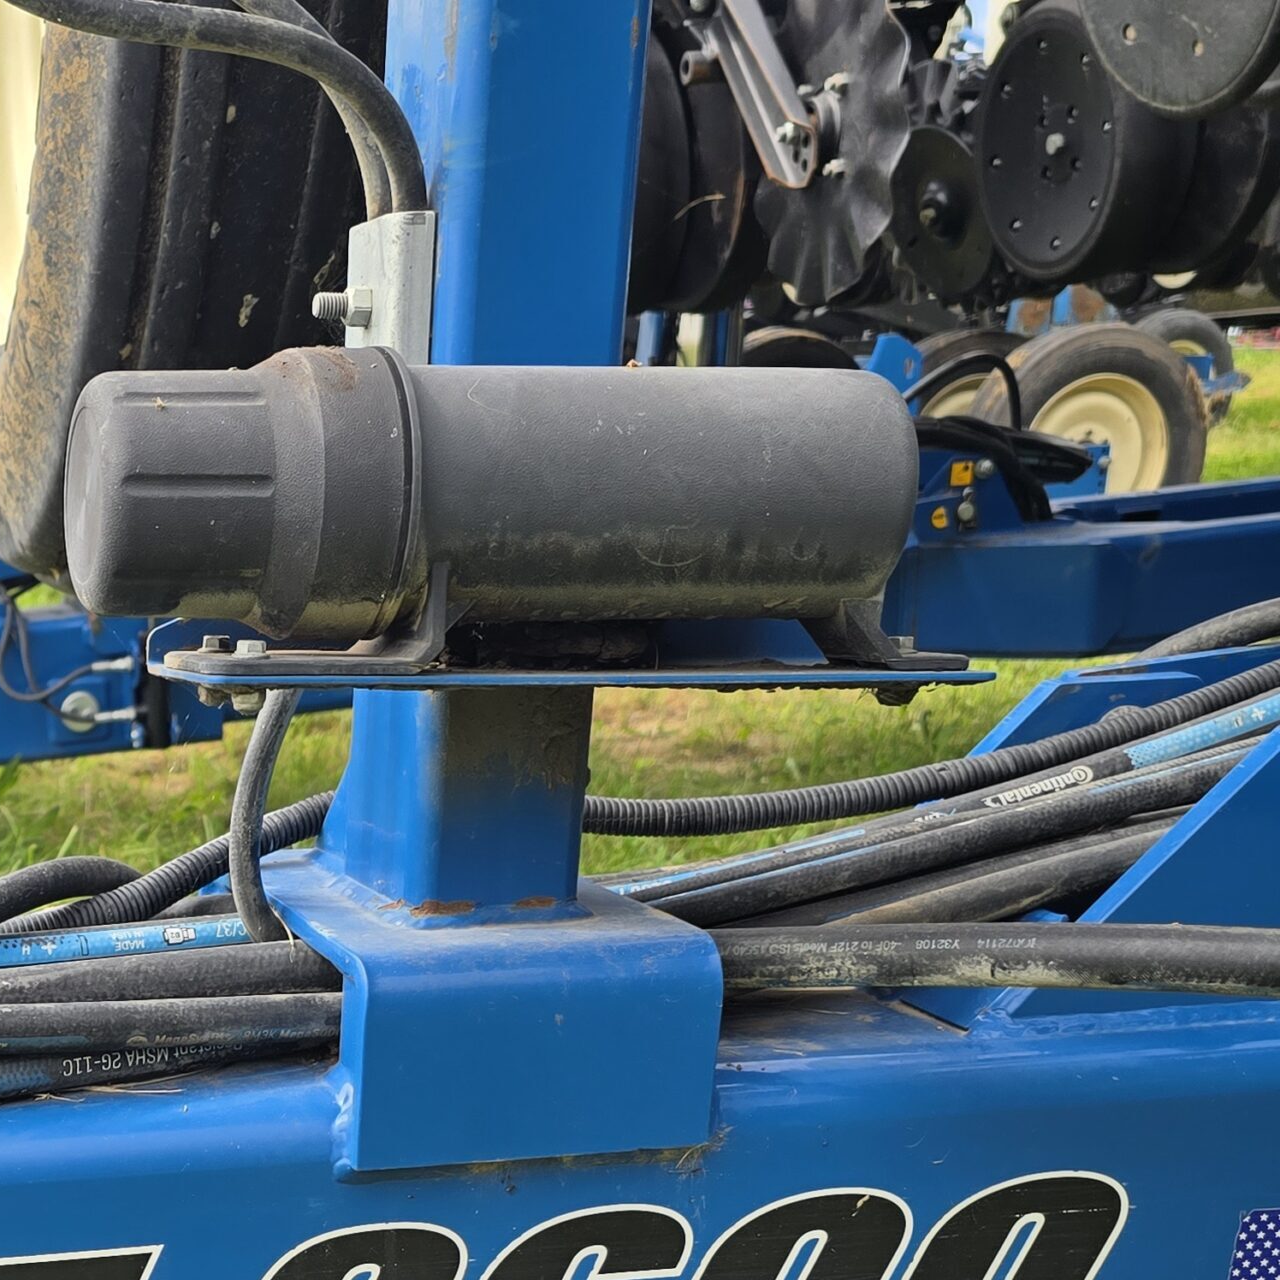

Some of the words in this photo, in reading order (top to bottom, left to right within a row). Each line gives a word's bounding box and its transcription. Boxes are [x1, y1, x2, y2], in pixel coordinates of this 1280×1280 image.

[1000, 765, 1094, 806] Continental
[115, 939, 145, 951] MADE
[63, 1053, 122, 1077] 2G-11C
[126, 1048, 170, 1067] MSHA
